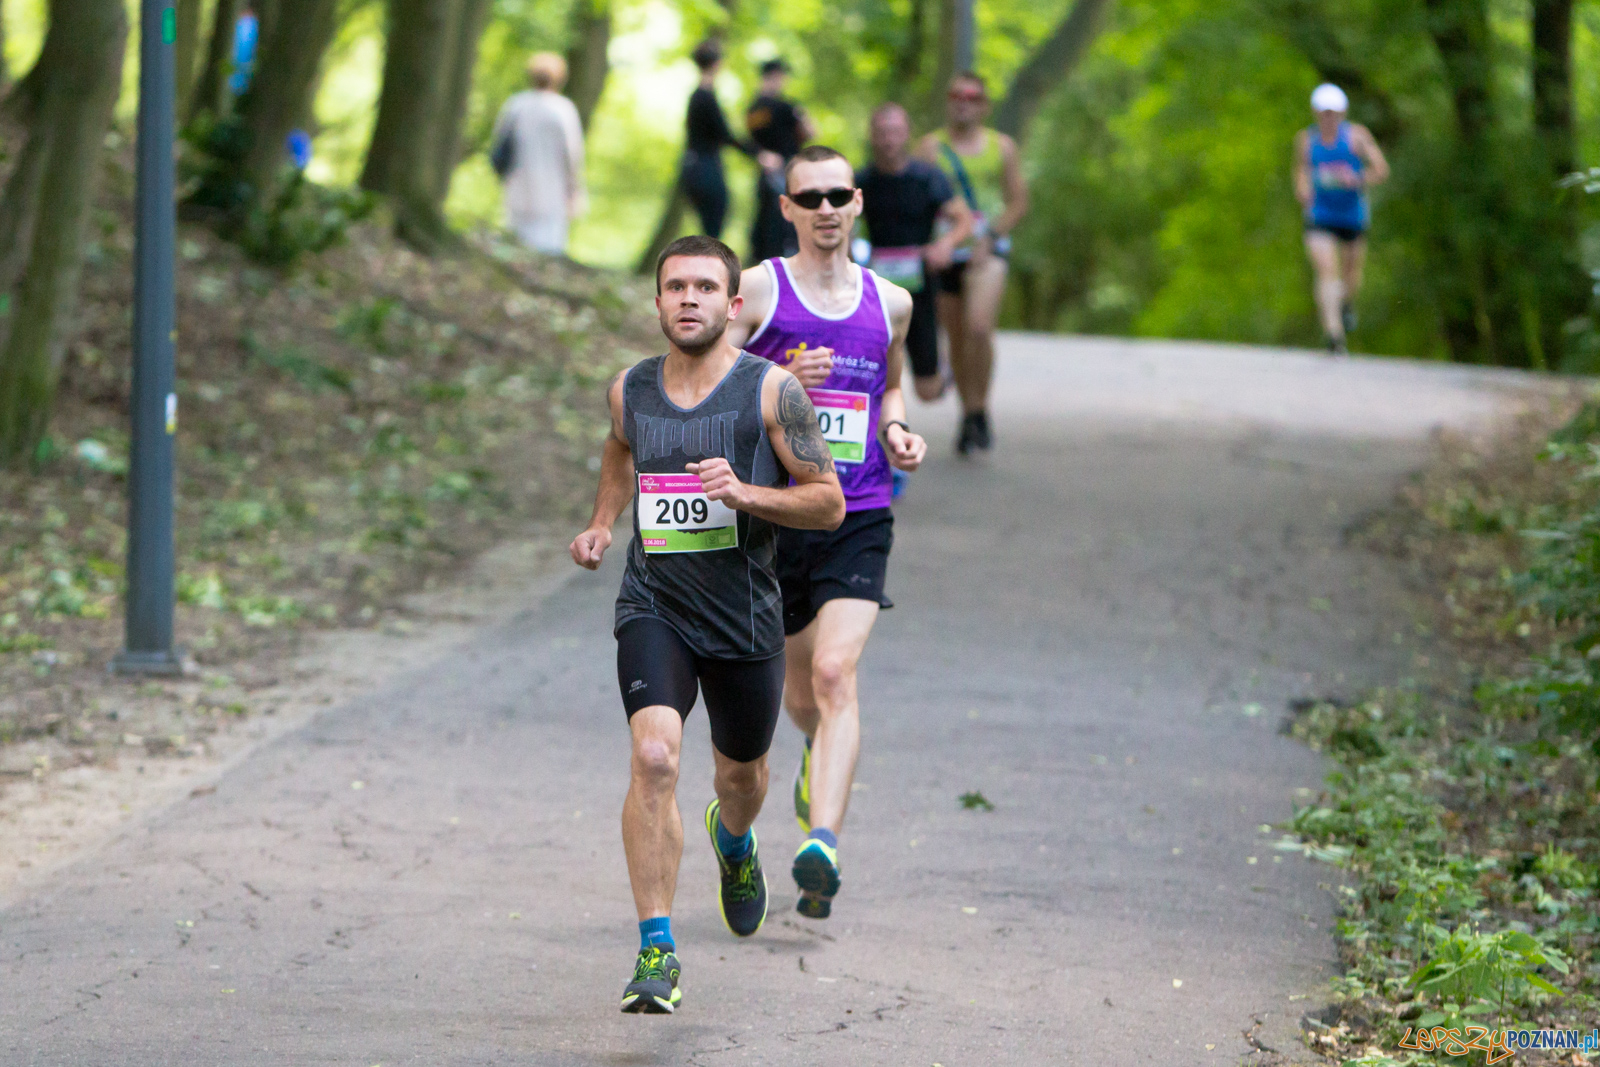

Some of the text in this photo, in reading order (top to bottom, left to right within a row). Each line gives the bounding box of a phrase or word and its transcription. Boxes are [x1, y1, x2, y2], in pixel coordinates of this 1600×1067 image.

[818, 411, 845, 435] 01
[634, 411, 738, 463] TAPOUT
[656, 498, 708, 524] 209
